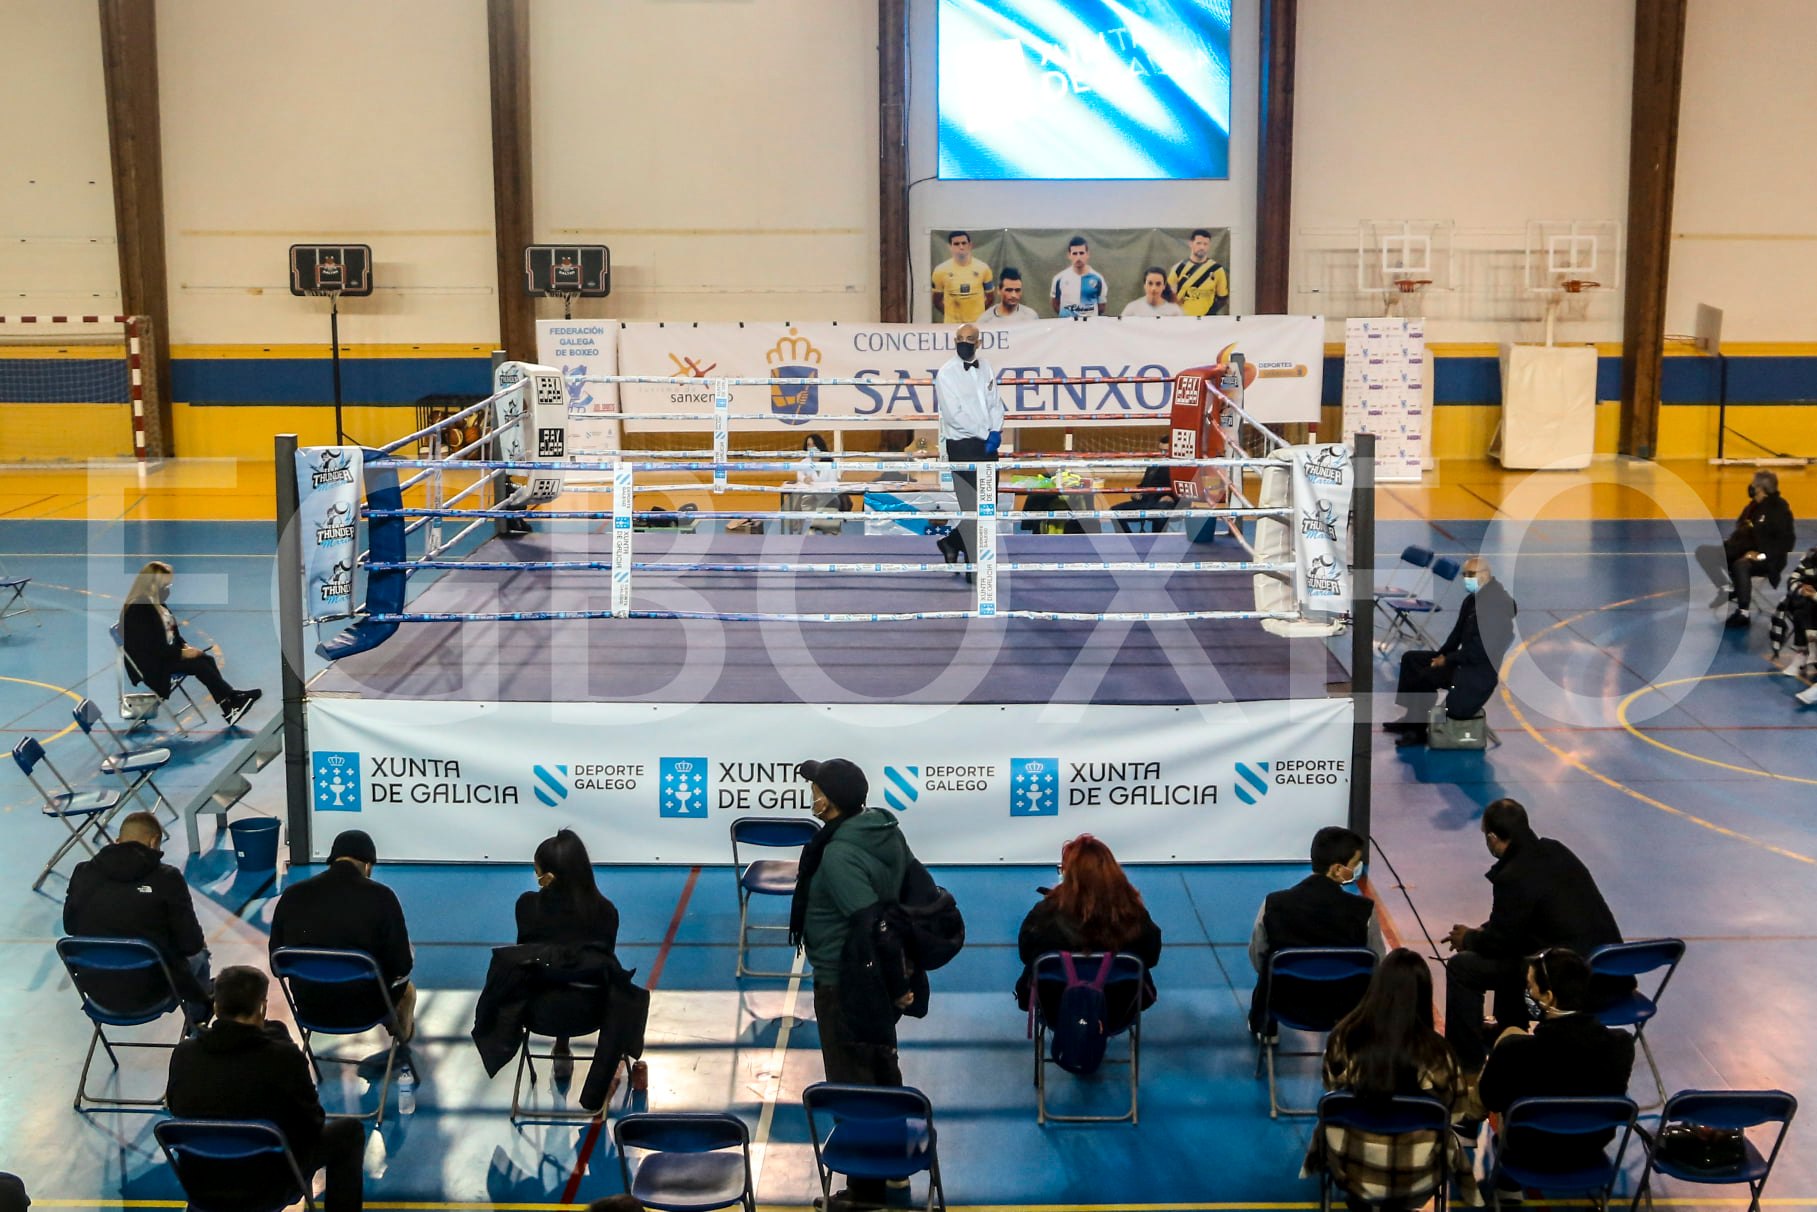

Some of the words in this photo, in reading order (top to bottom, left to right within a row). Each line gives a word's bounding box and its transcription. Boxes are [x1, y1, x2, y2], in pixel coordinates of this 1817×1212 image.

[549, 327, 604, 335] FEDERACIÓN
[559, 338, 595, 346] GALEGA
[853, 331, 957, 352] CONCELL
[980, 331, 1010, 350] DE
[555, 349, 567, 357] DE
[670, 392, 734, 403] sanxeno
[854, 364, 1173, 415] SAENXO
[313, 468, 353, 488] THUNDER
[1304, 464, 1342, 485] THUNDER
[317, 526, 355, 544] THUNDER
[322, 583, 353, 599] THUND
[1307, 577, 1340, 596] HUNDER
[371, 756, 460, 779] XUNTA
[574, 764, 645, 777] DEPORTE
[925, 765, 996, 777] DEPORTE
[1069, 762, 1161, 783] XUNTA
[1275, 760, 1346, 772] DEPORTE
[574, 778, 637, 791] GALEGO
[925, 779, 989, 792] GALEGO
[1275, 773, 1338, 785] GALEGO
[370, 784, 402, 804] DE
[410, 783, 519, 805] GALICIA
[718, 789, 751, 809] DE
[1069, 786, 1099, 806] DE
[1108, 784, 1218, 806] GALICIA
